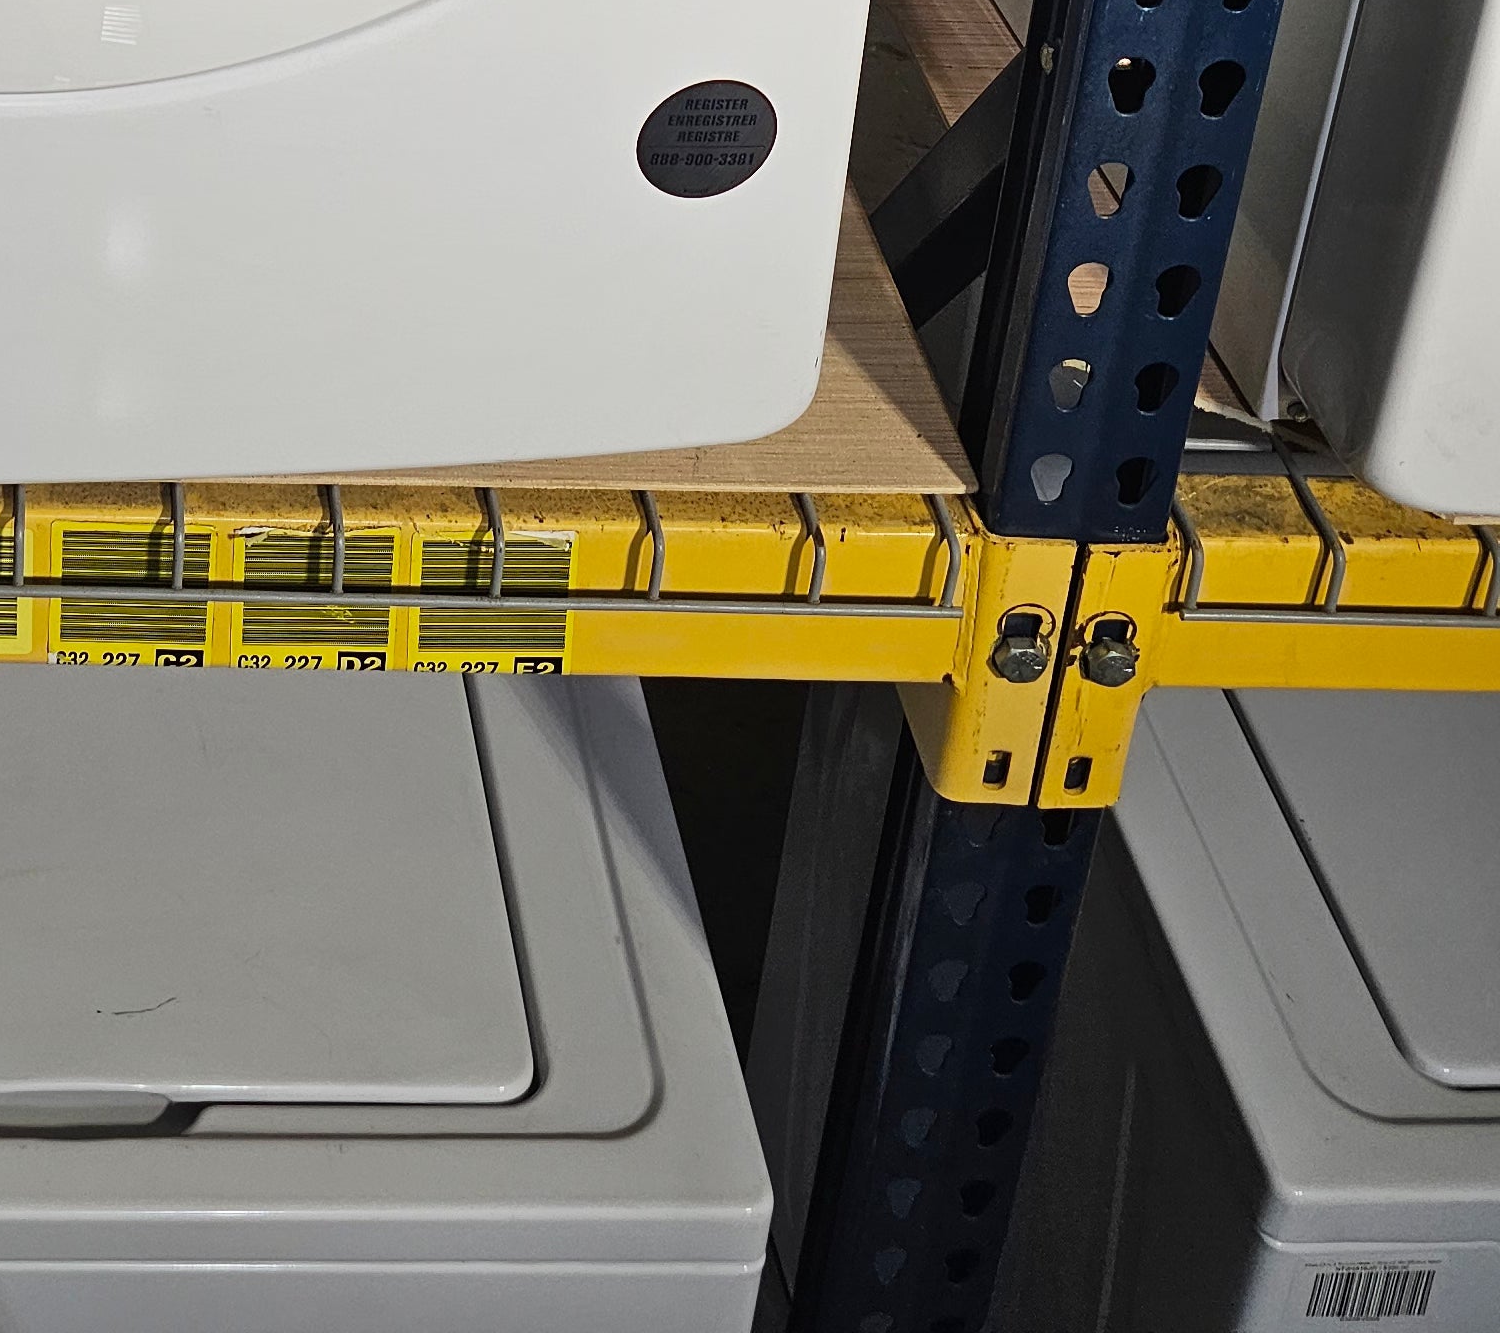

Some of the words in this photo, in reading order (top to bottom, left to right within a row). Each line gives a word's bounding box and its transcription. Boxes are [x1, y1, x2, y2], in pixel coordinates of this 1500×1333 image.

[684, 98, 750, 111] REGISTER
[667, 113, 758, 127] ENREGISTRER
[676, 130, 741, 143] REGISTRE
[650, 152, 756, 166] 888-900-3381
